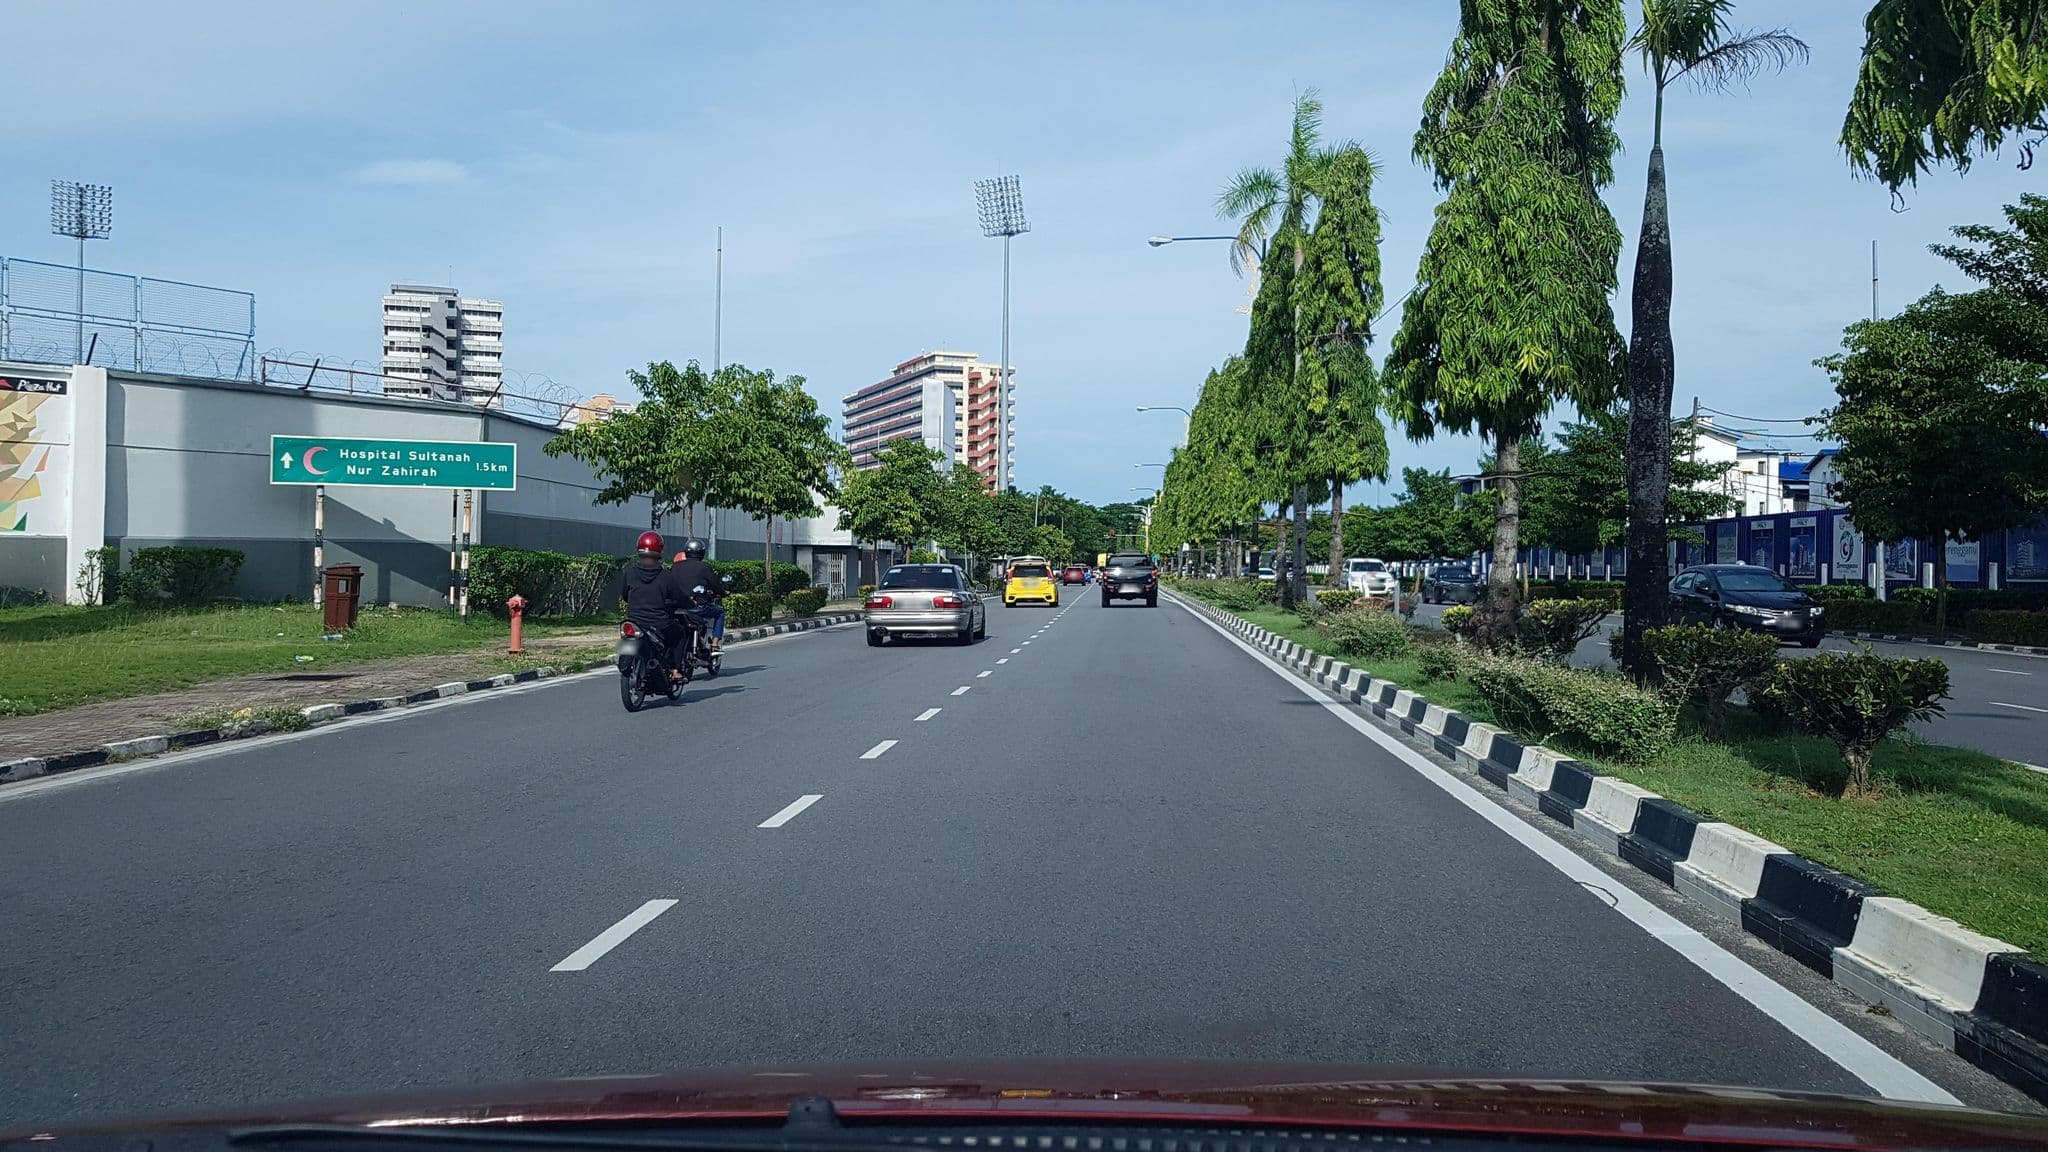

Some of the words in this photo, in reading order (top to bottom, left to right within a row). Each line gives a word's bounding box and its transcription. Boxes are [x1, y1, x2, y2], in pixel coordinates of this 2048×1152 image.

[46, 381, 62, 392] Hut
[340, 448, 400, 461] Hospital
[409, 451, 470, 462] Sultanah
[347, 465, 372, 475] Nur
[382, 465, 437, 477] Zahirah
